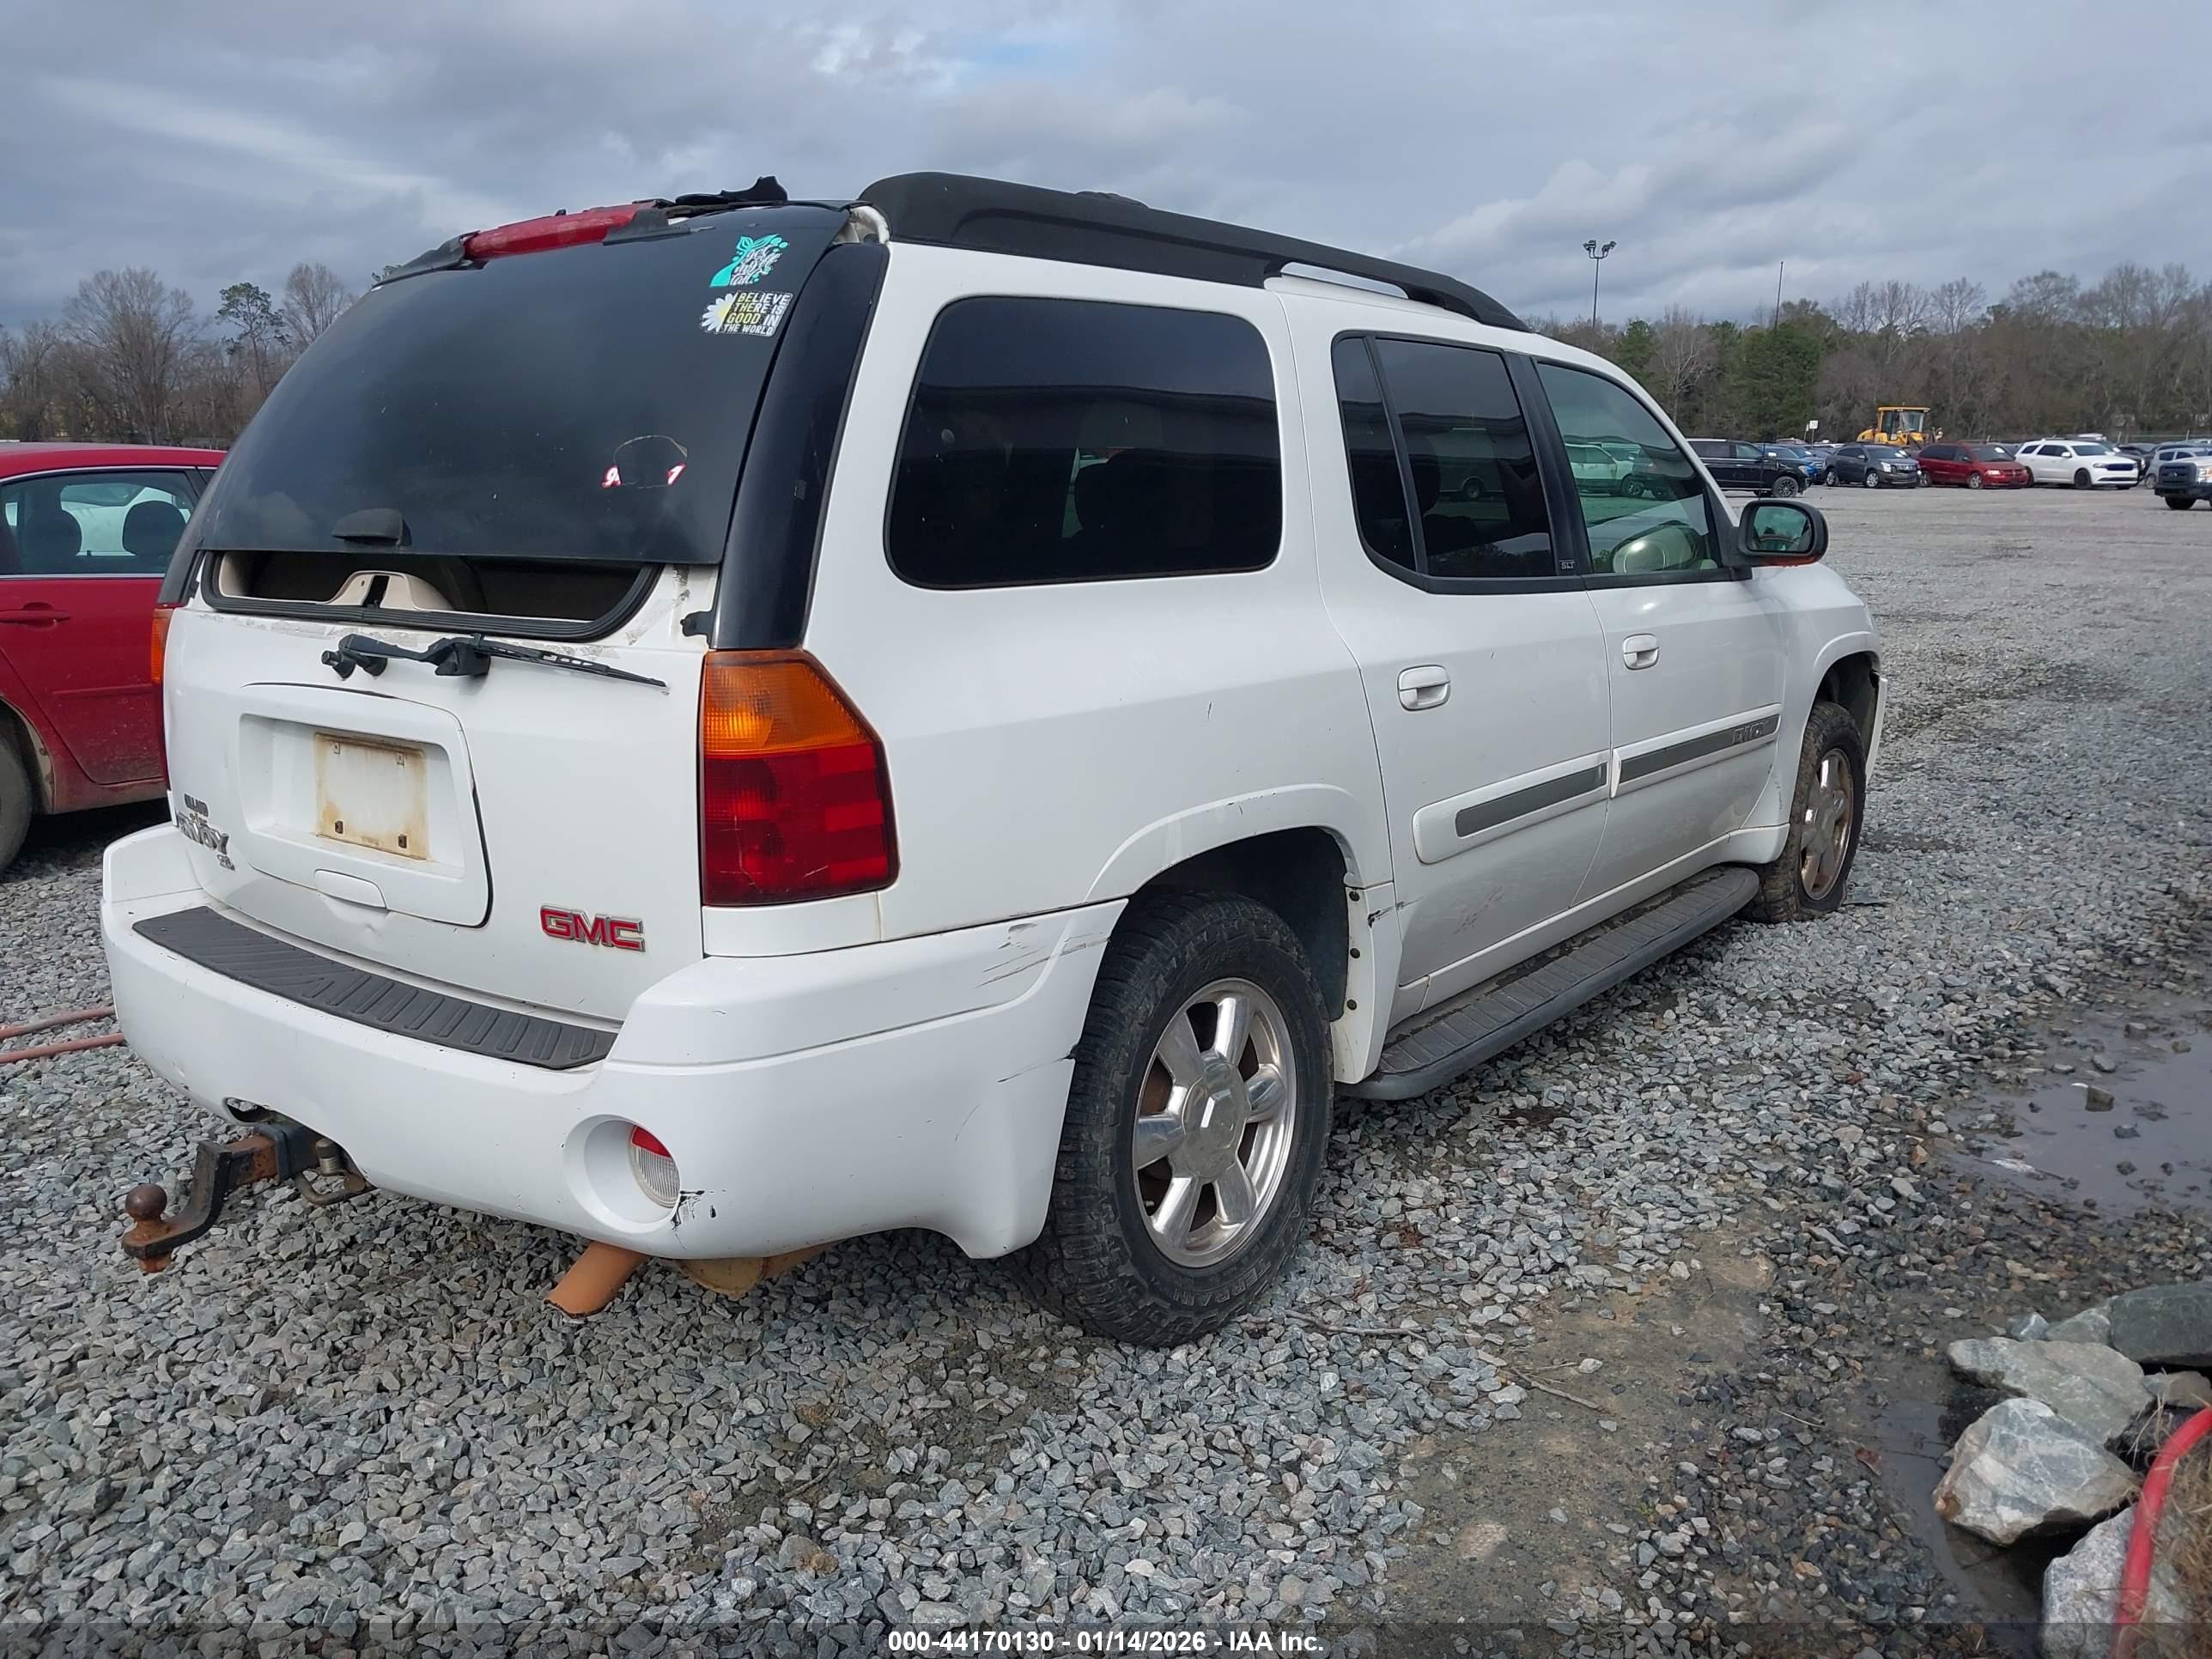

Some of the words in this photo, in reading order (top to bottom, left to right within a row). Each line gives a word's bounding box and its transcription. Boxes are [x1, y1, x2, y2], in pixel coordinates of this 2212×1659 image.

[738, 292, 790, 306] BELIEVE
[734, 302, 770, 313] THERE
[771, 304, 784, 315] IS
[726, 313, 761, 325] GOOD
[763, 314, 780, 327] IN
[723, 324, 740, 332] THE
[742, 324, 774, 335] WORLD
[540, 904, 646, 952] GMC
